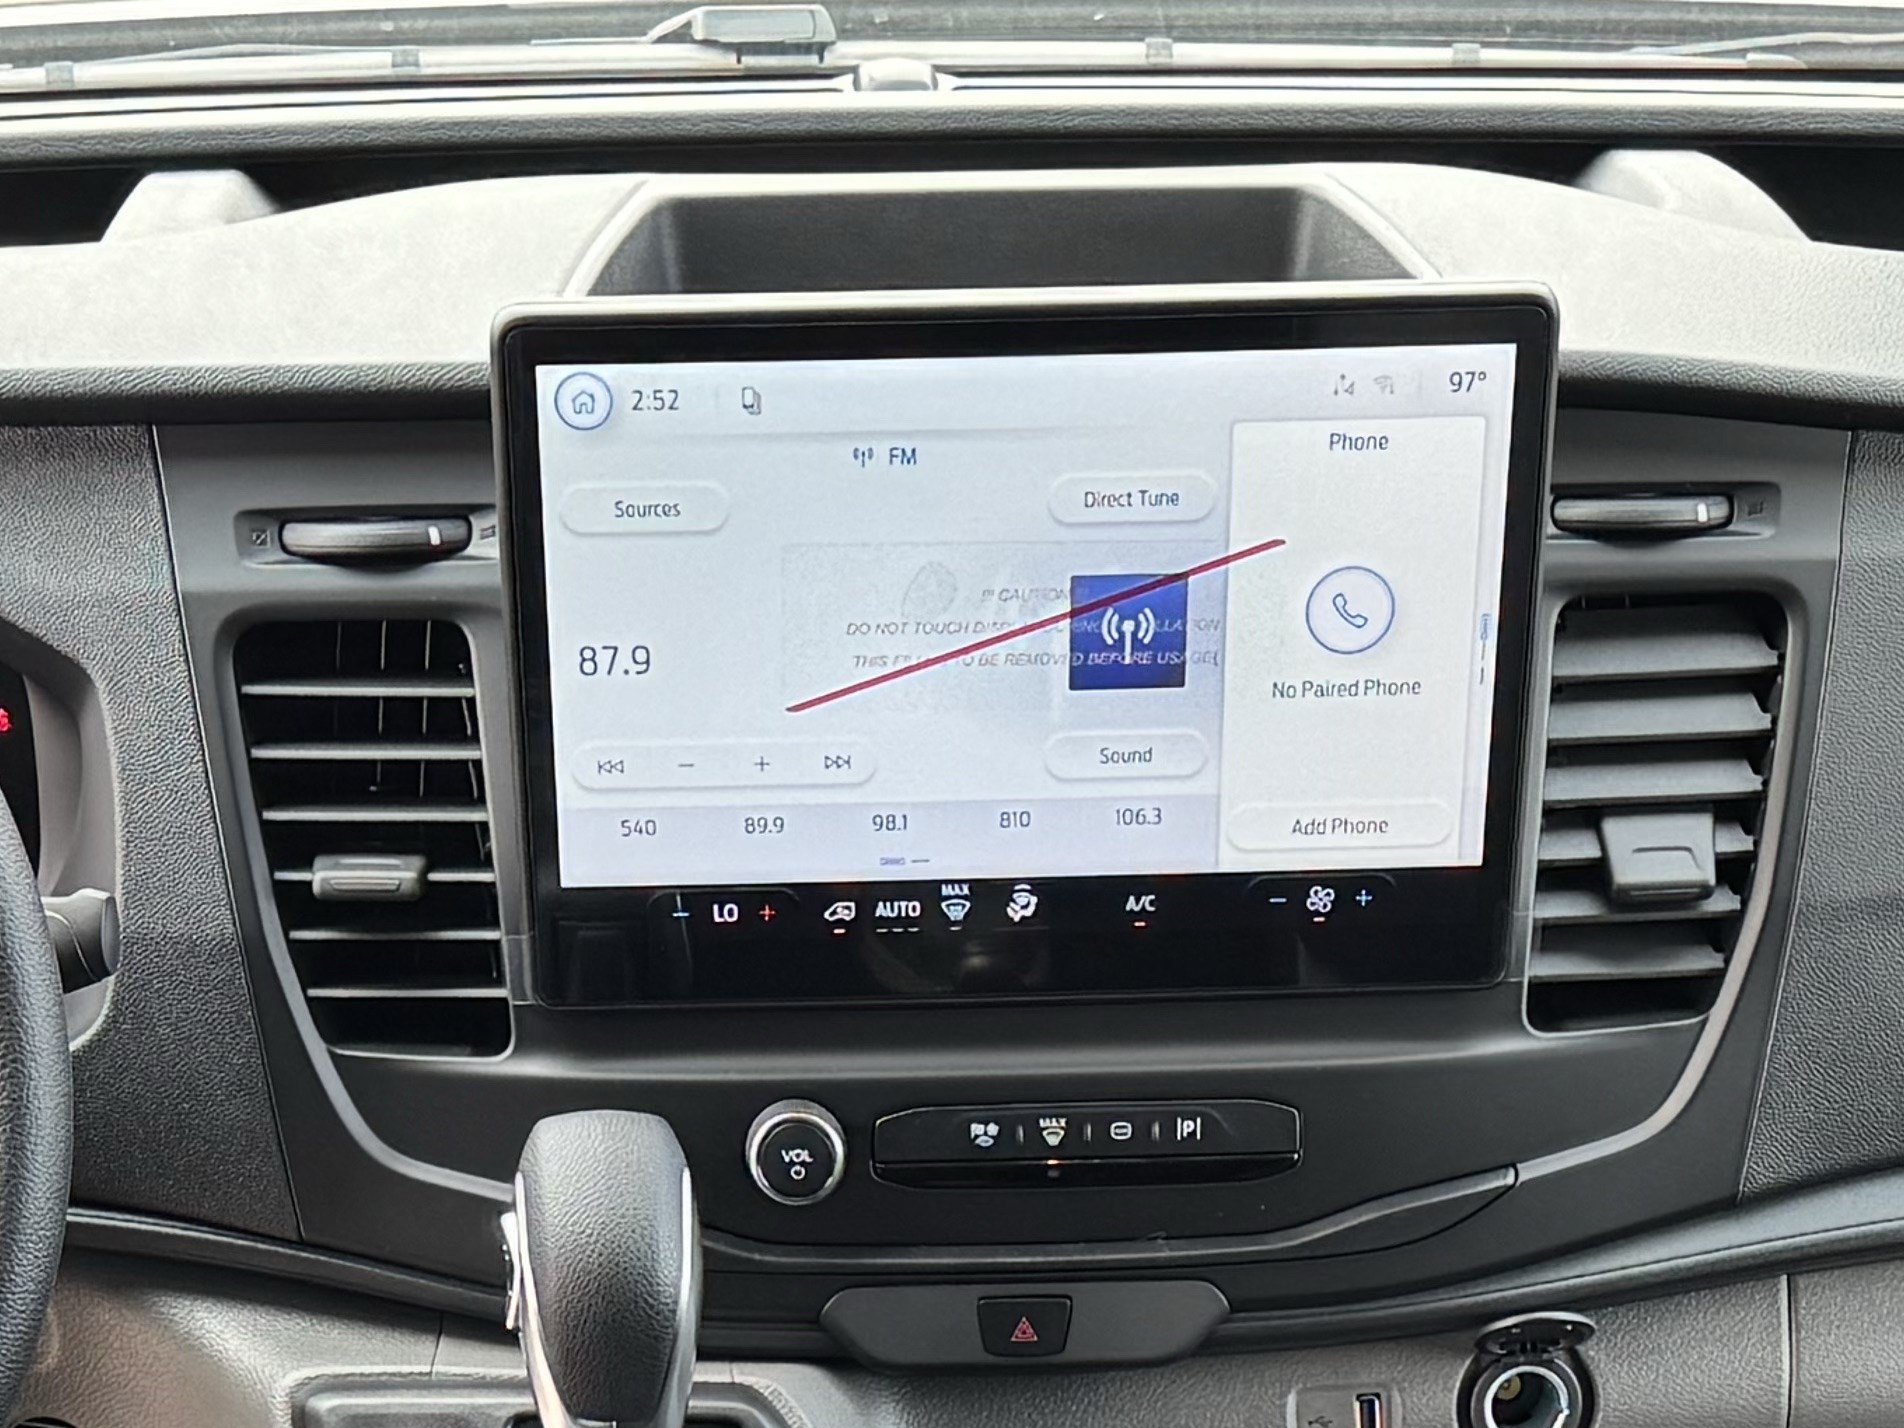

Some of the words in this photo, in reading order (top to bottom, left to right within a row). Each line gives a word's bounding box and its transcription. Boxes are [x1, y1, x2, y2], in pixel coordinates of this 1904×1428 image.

[1448, 371, 1488, 394] 97°
[631, 388, 680, 411] 2:52
[1329, 432, 1389, 451] Phone
[889, 447, 917, 466] FM
[1084, 490, 1133, 508] Direct
[1138, 490, 1179, 507] Tune
[614, 500, 681, 519] Sources
[846, 622, 871, 635] DO
[875, 622, 908, 635] NOT
[914, 621, 969, 634] TOUCH
[578, 645, 652, 677] 87.9
[1272, 681, 1297, 699] No
[1301, 680, 1359, 698] Paired
[1363, 678, 1422, 697] Phone
[1099, 747, 1153, 765] Sound
[744, 816, 785, 835] 89.9
[872, 814, 908, 832] 98.1
[999, 810, 1031, 828] 810
[1115, 807, 1162, 826] 106.3
[620, 819, 658, 837] 540
[1292, 818, 1328, 836] Add
[1331, 817, 1389, 835] Phone
[941, 883, 970, 896] MAX
[713, 904, 739, 923] LO
[875, 901, 921, 918] AUTO
[1125, 895, 1156, 913] A/C
[781, 1148, 813, 1163] VOL
